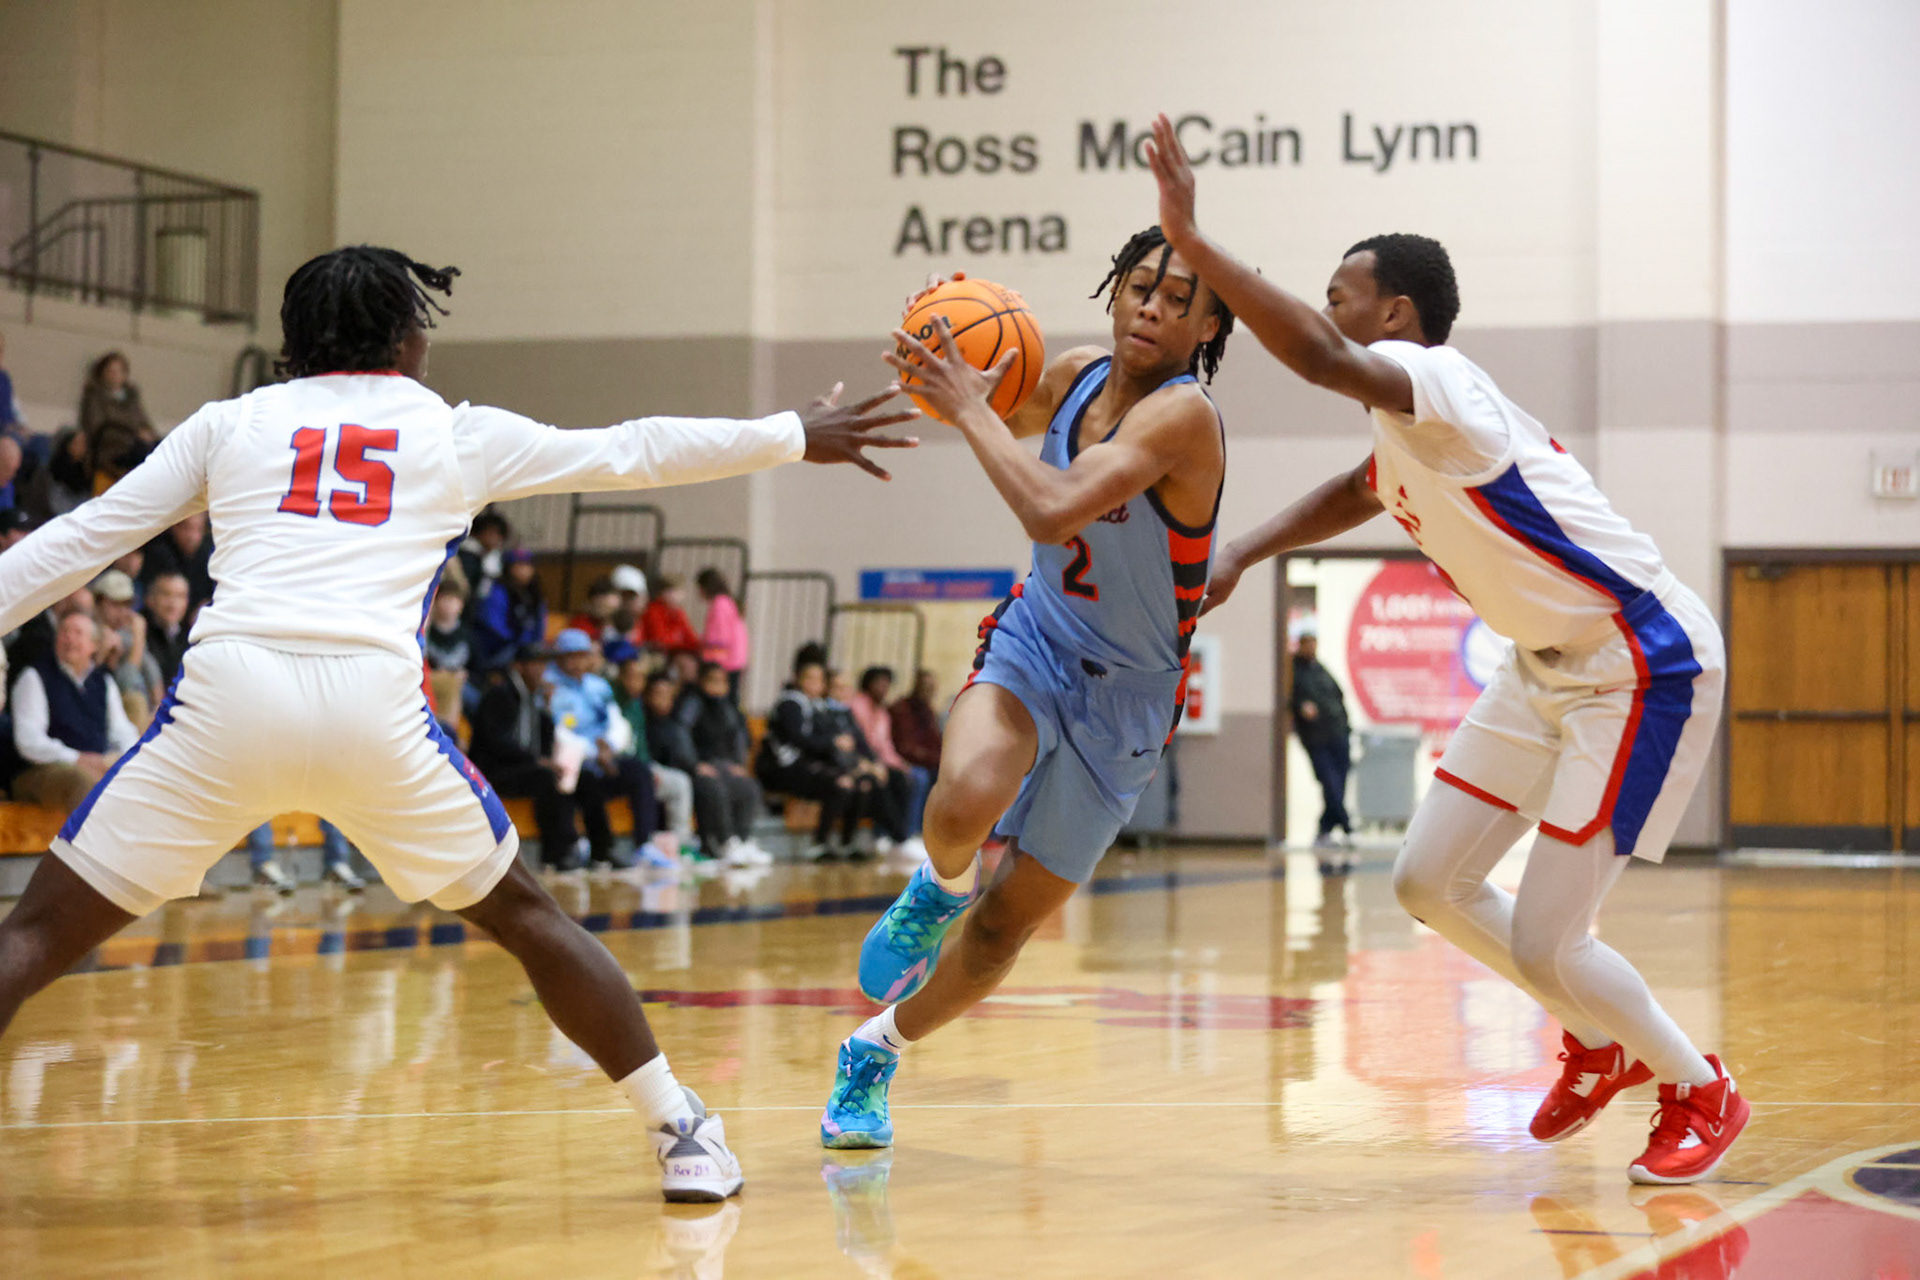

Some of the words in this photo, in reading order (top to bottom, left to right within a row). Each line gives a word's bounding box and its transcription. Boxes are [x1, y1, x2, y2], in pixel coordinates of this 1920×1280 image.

[895, 46, 1006, 96] The
[893, 126, 1038, 176] Ross
[1079, 112, 1299, 169] McCain
[1345, 115, 1476, 170] Lynn
[895, 206, 1067, 255] Arena
[277, 423, 400, 528] 15
[1061, 534, 1100, 602] 2
